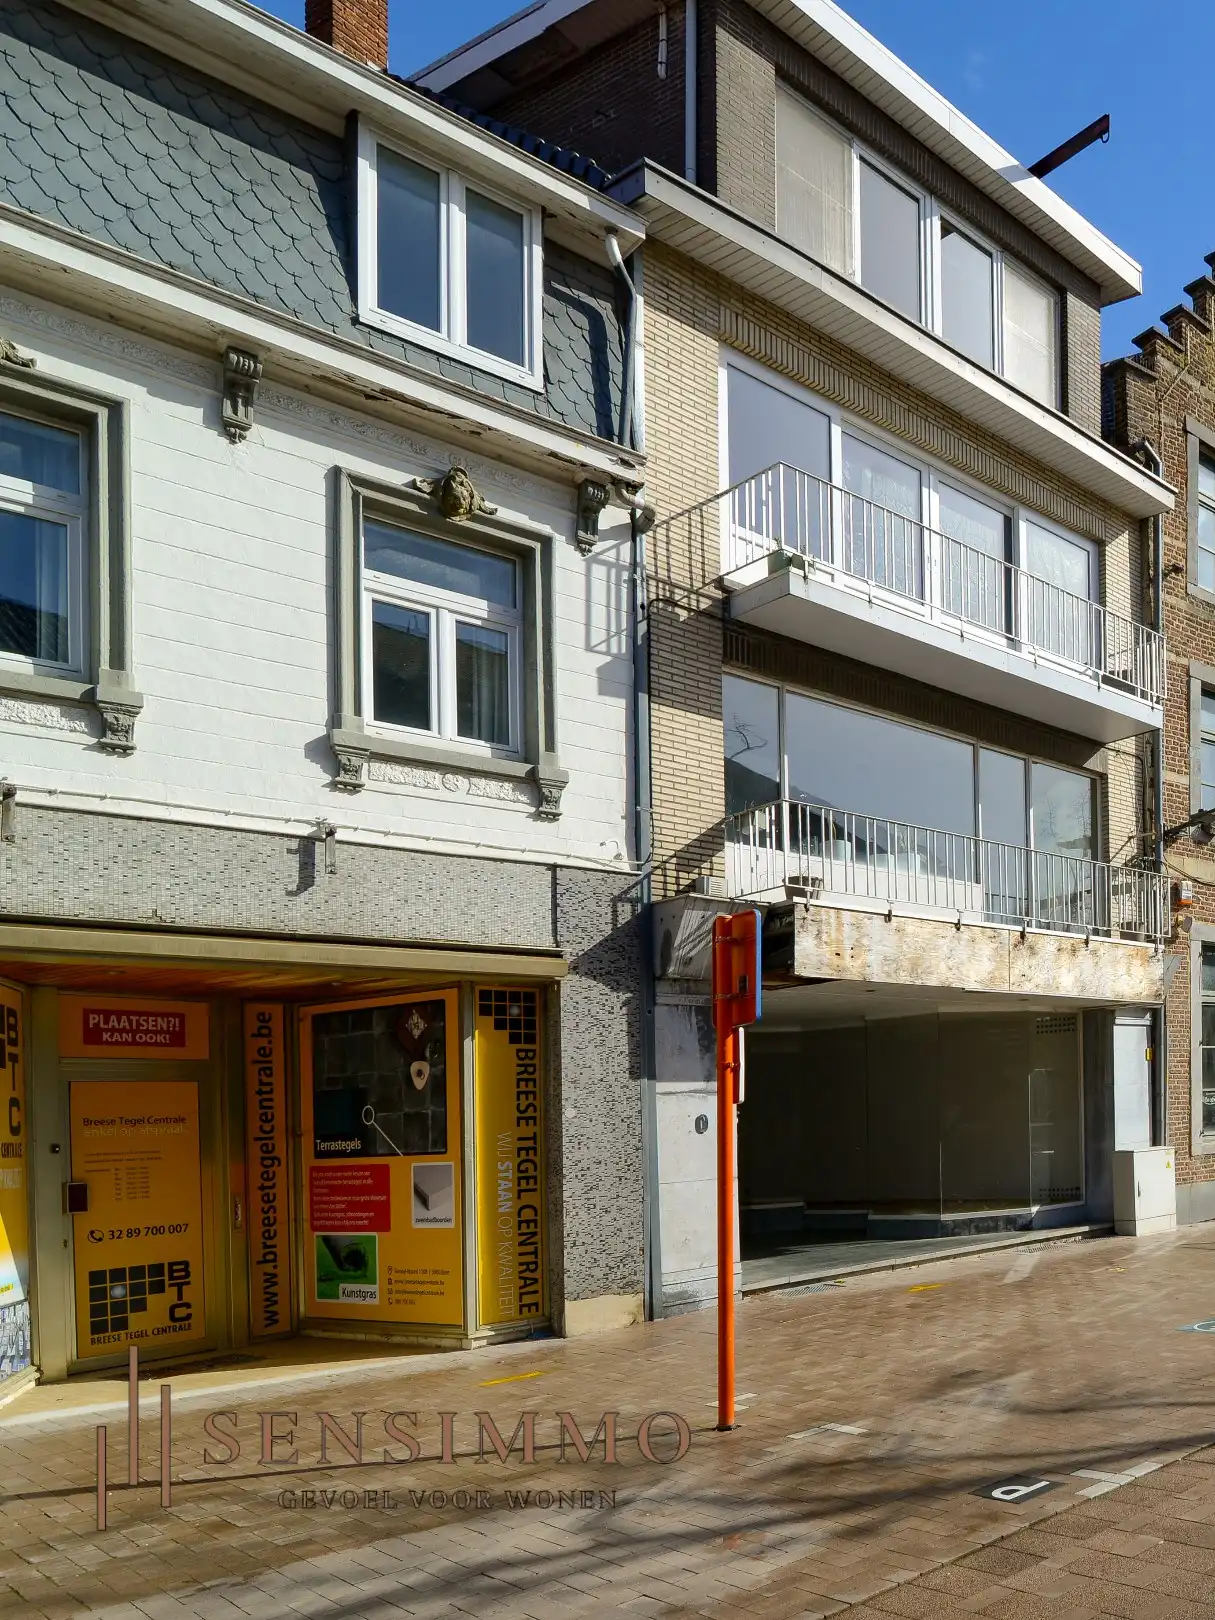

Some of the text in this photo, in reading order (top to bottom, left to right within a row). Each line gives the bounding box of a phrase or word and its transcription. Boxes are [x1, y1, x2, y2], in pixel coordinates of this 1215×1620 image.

[89, 1013, 180, 1031] PLAATSEN?!
[102, 1031, 171, 1043] KAN OOK!
[82, 1114, 187, 1127] Breese Tegel Centrale
[316, 1137, 362, 1152] Terrastegels
[251, 1010, 281, 1329] www.breesetegelcentrale.be
[497, 1160, 513, 1213] STAAN
[515, 1048, 539, 1315] BREESE TEGEL CENTRALE
[108, 1223, 189, 1240] 32 89 700 007
[498, 1216, 513, 1237] OP
[498, 1241, 515, 1317] KWALITEIT
[341, 1287, 377, 1301] Kunstgras
[90, 1322, 192, 1346] BREESE TEGEL CENTRALE
